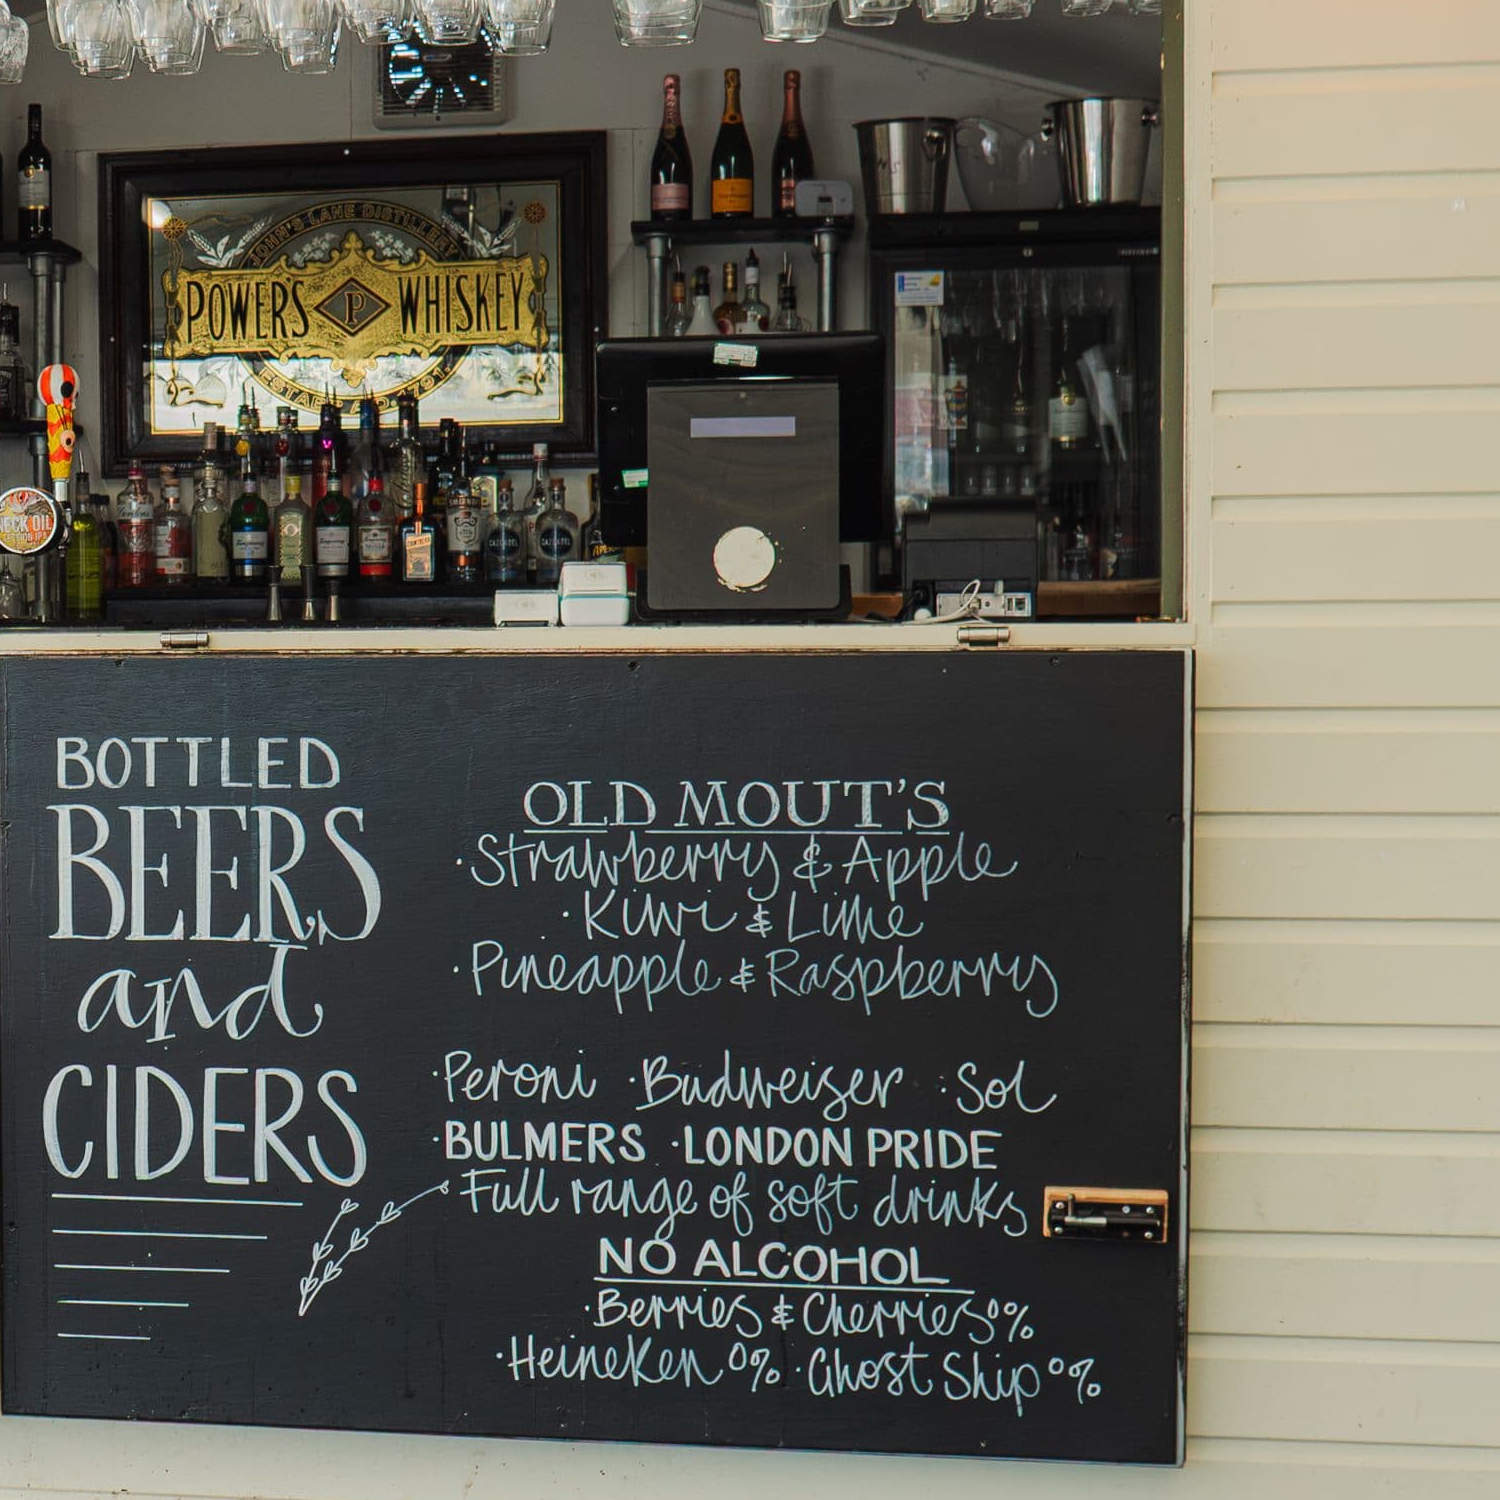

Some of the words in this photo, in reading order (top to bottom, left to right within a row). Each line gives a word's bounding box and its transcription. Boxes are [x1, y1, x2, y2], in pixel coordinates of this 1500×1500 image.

[308, 204, 356, 226] LANE
[361, 203, 460, 256] DISTILLERY
[185, 275, 310, 344] POWER'S
[343, 290, 368, 326] P
[396, 270, 526, 335] WHISKEY
[32, 514, 53, 532] OIL
[56, 737, 340, 790] BOTTLED
[523, 781, 656, 828] OLD
[673, 779, 950, 829] MOUT'S
[46, 804, 382, 944] BEERS
[470, 830, 779, 901] Strawberry
[793, 833, 833, 893] &
[843, 835, 1018, 900] Apple
[584, 889, 737, 940] Kiwi
[746, 902, 773, 938] &
[788, 891, 924, 944] Lime
[77, 944, 323, 1043] and
[472, 936, 721, 1015] Pineapple
[730, 958, 755, 993] &
[765, 945, 1058, 1018] Raspberry
[444, 1050, 596, 1103] Peroni
[636, 1050, 903, 1121] Budweiser
[957, 1059, 1057, 1115] Sol
[42, 1064, 367, 1187] CIDERS
[445, 1121, 646, 1164] BULMERS
[684, 1126, 853, 1168] LONDON
[868, 1128, 1002, 1170] PRIDE
[460, 1168, 558, 1216] Full
[572, 1178, 697, 1241] range
[709, 1173, 753, 1237] of
[767, 1173, 858, 1236] soft
[873, 1176, 1028, 1237] drinks
[600, 1238, 677, 1276] NO
[693, 1239, 950, 1285] ALCOHOL
[593, 1287, 763, 1339] Berries
[773, 1294, 795, 1328] &
[507, 1335, 723, 1388] Heineken
[807, 1352, 934, 1396] Ghost
[942, 1352, 1041, 1418] Ship
